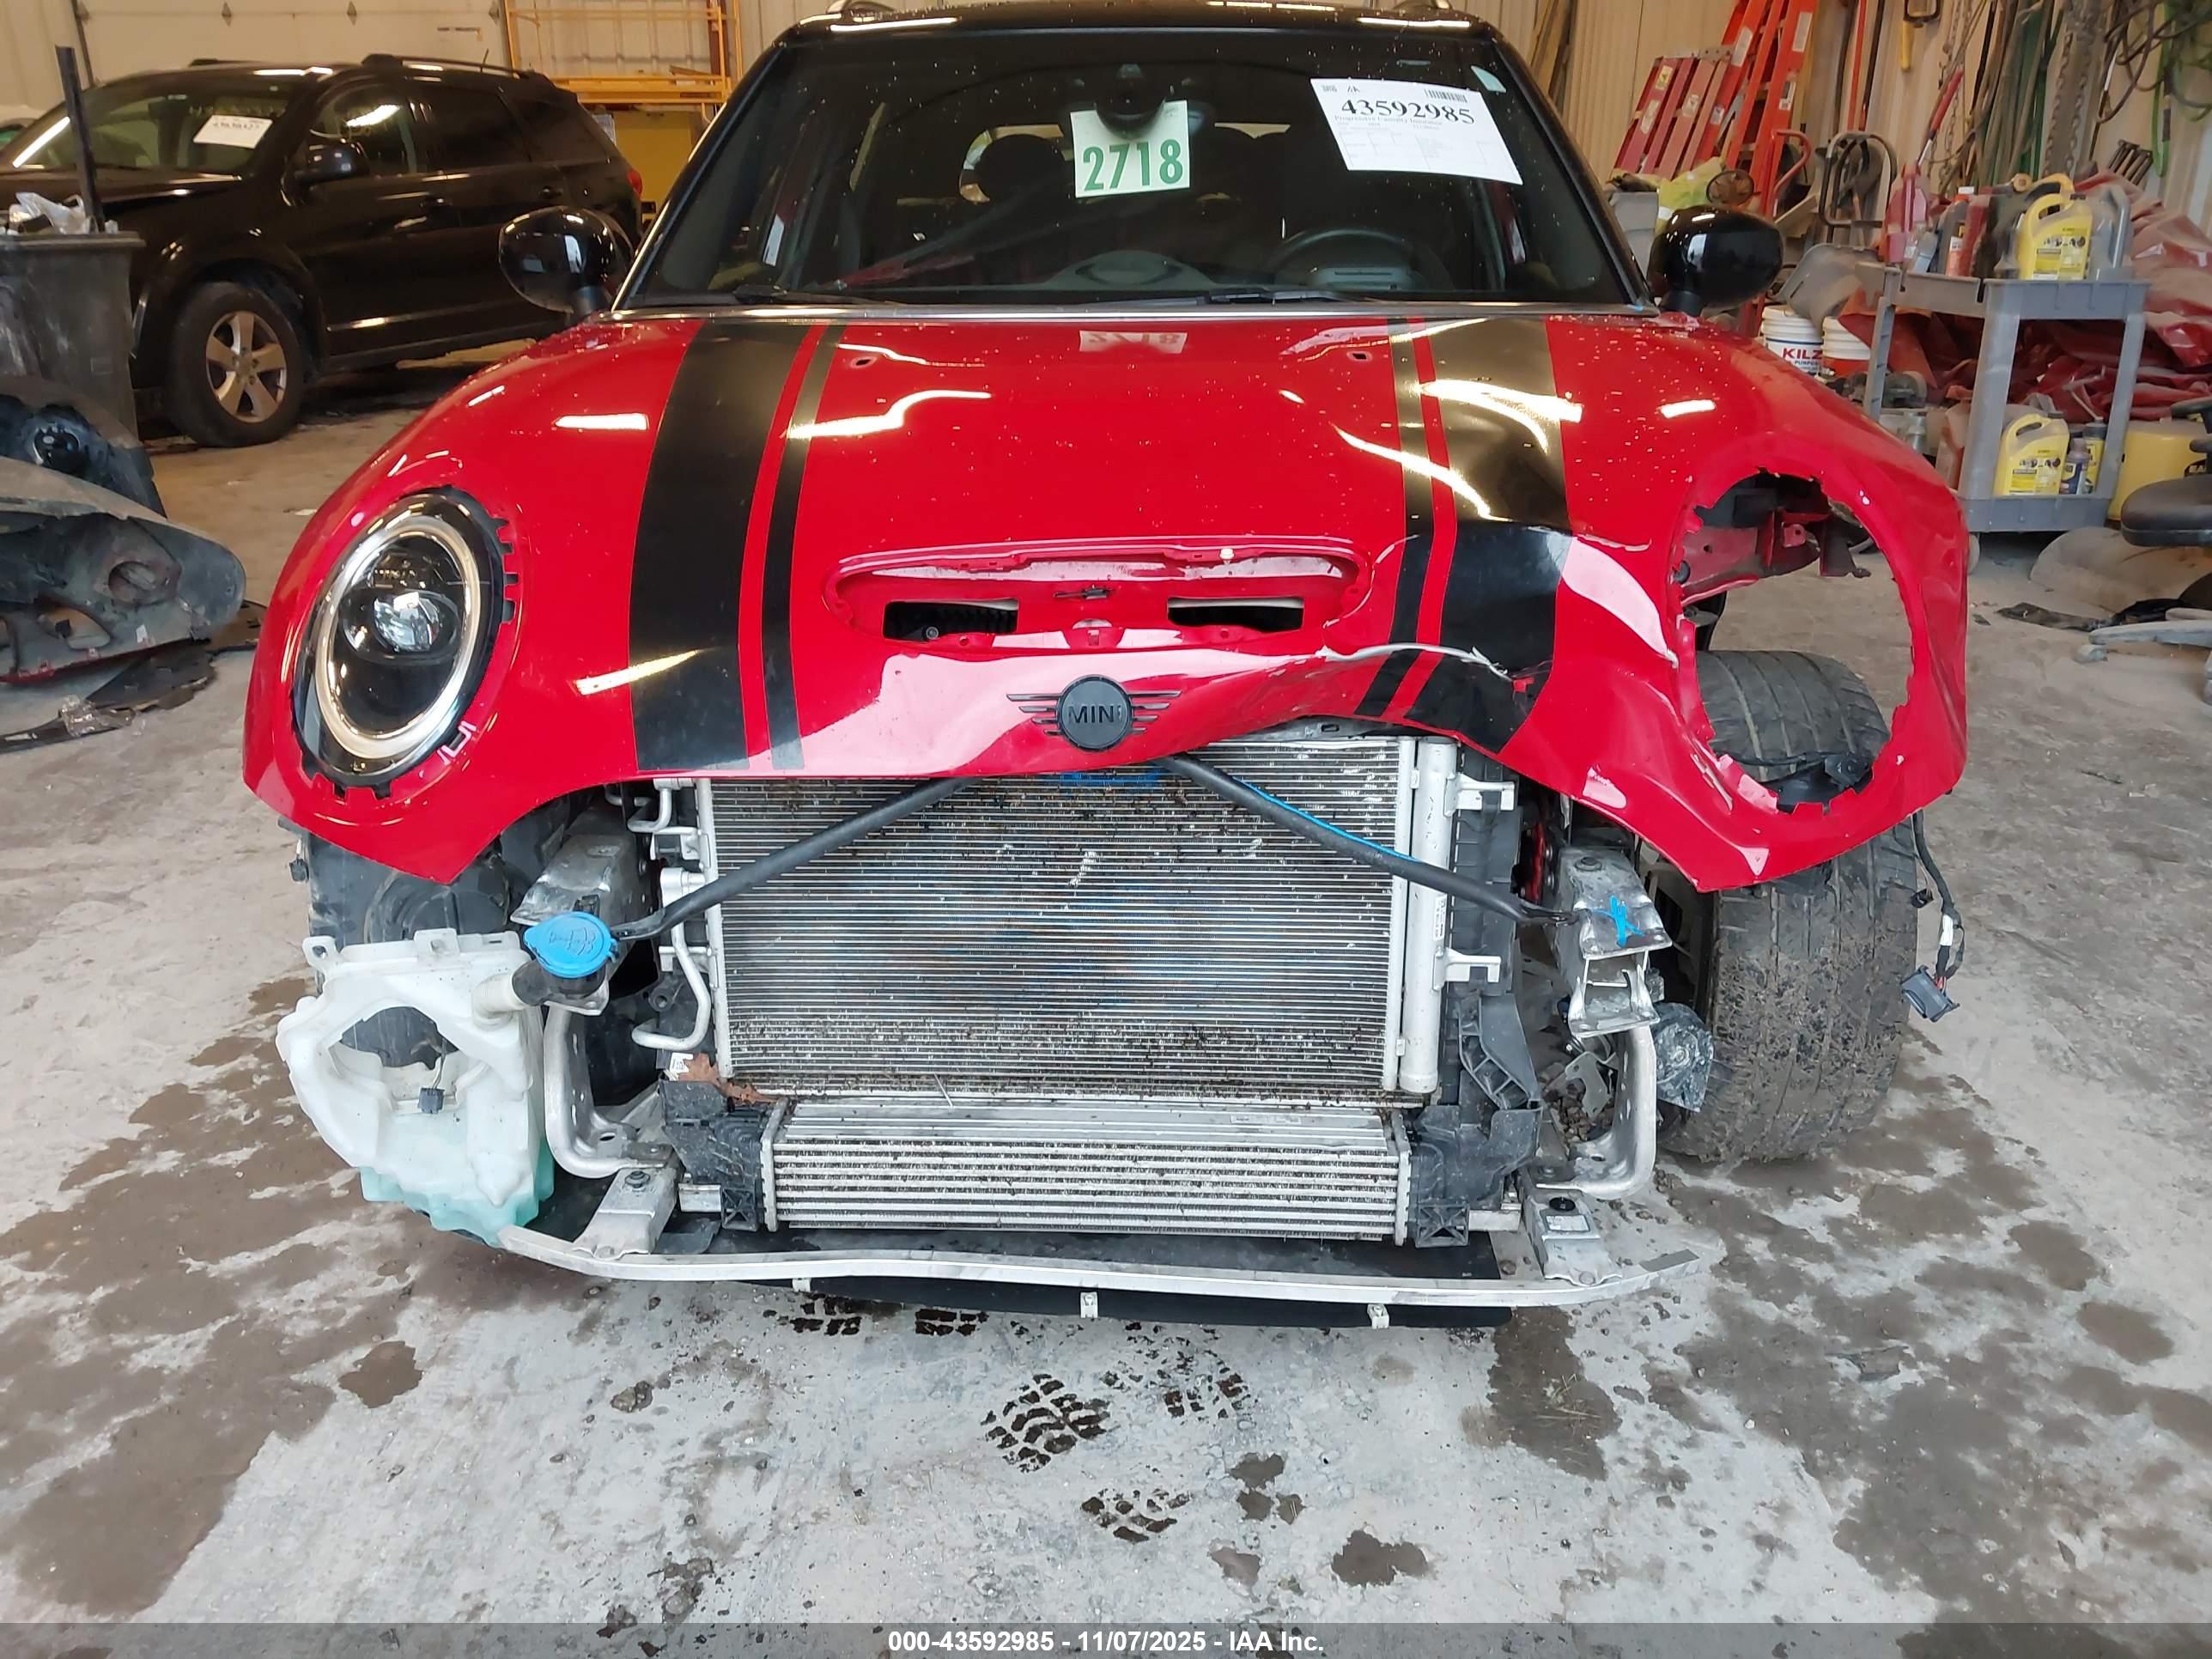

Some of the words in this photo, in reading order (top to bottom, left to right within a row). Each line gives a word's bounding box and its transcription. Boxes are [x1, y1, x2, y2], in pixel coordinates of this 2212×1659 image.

[1341, 99, 1475, 125] 43592985
[1082, 138, 1183, 191] 2718
[1067, 703, 1123, 724] MINI
